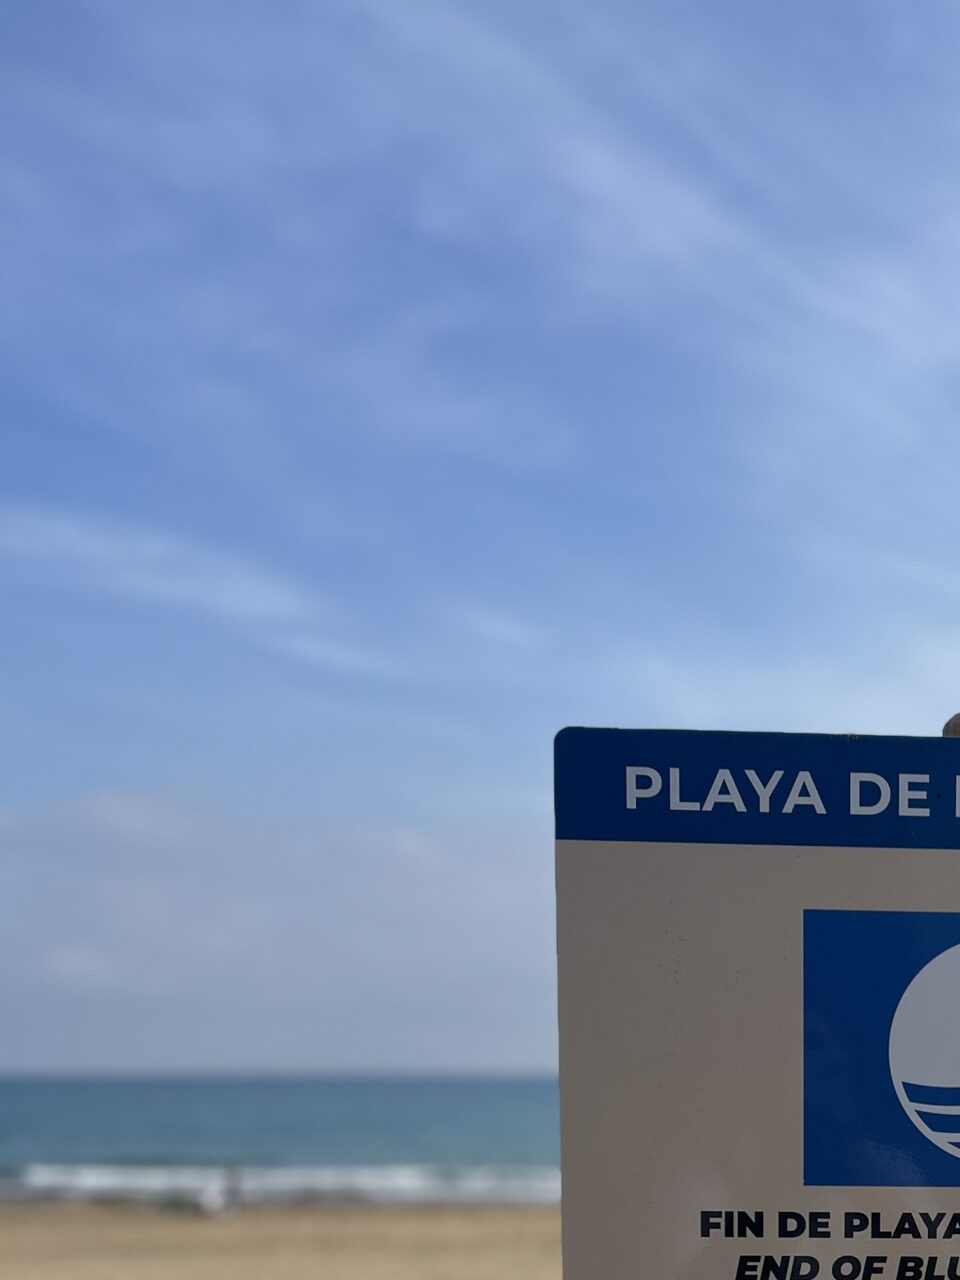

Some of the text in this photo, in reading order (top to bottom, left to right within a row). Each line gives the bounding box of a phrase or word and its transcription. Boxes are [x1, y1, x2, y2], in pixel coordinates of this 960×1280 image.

[625, 765, 827, 815] PLAYA
[849, 771, 931, 817] DE
[700, 1210, 764, 1238] FIN
[778, 1211, 831, 1239] DE
